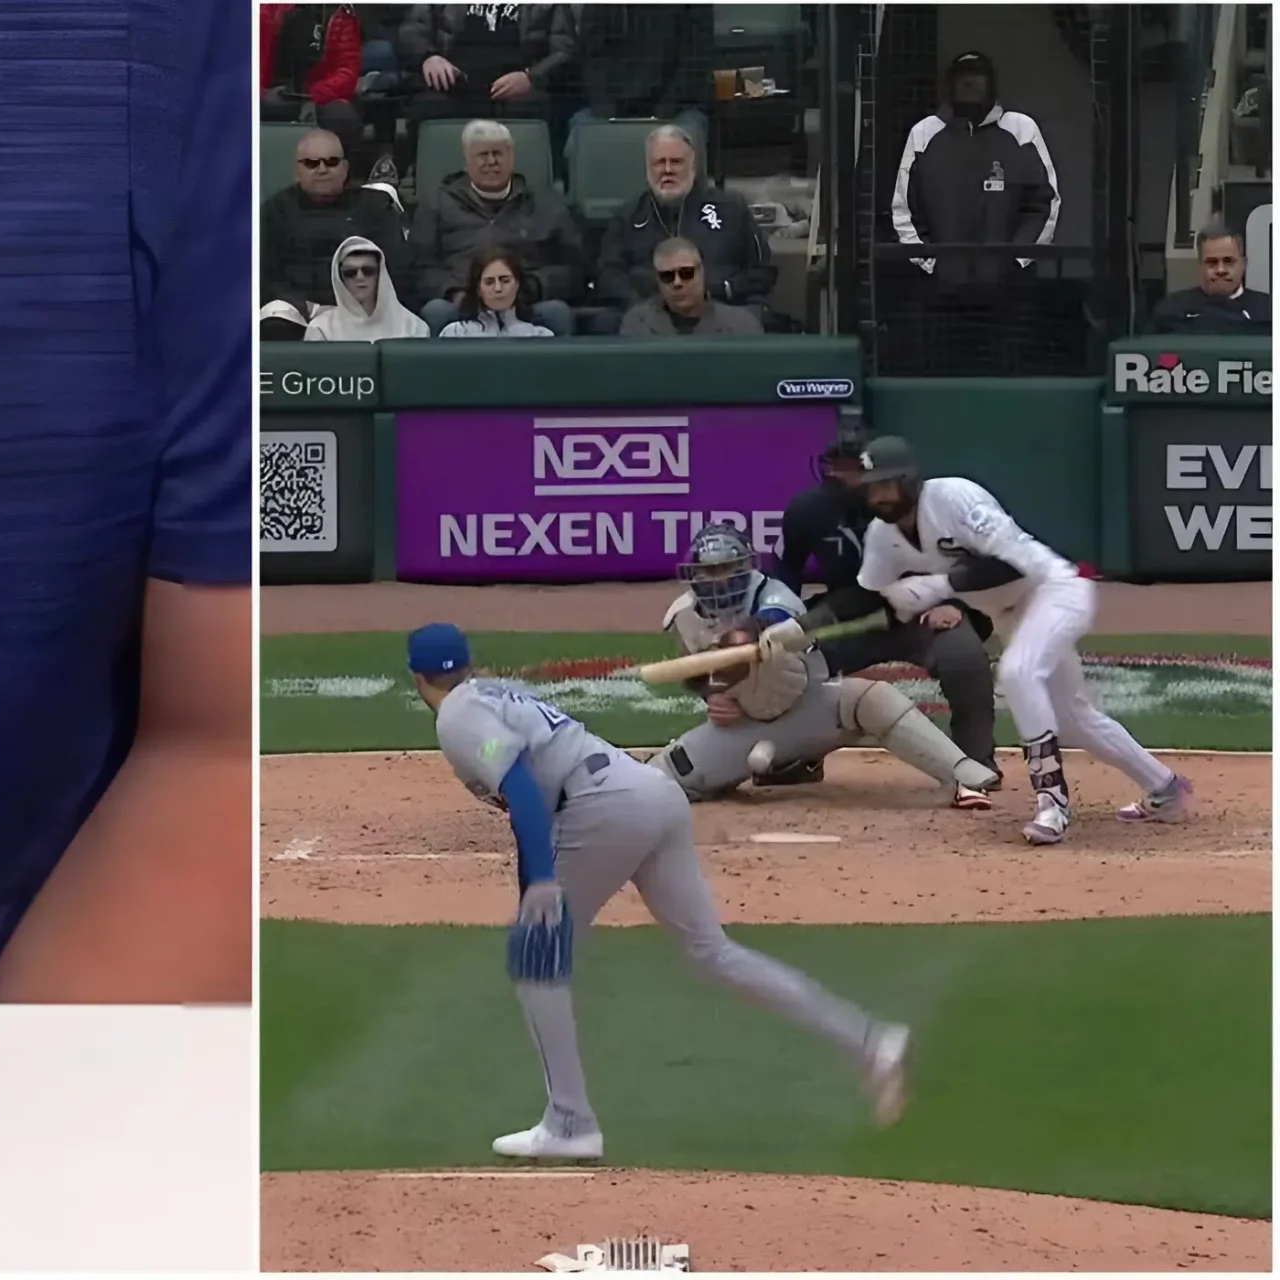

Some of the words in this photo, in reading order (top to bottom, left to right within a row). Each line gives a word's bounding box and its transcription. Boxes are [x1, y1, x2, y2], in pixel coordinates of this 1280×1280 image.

[282, 371, 375, 400] Group
[1115, 353, 1210, 394] Rate
[440, 513, 634, 557] NEXEN
